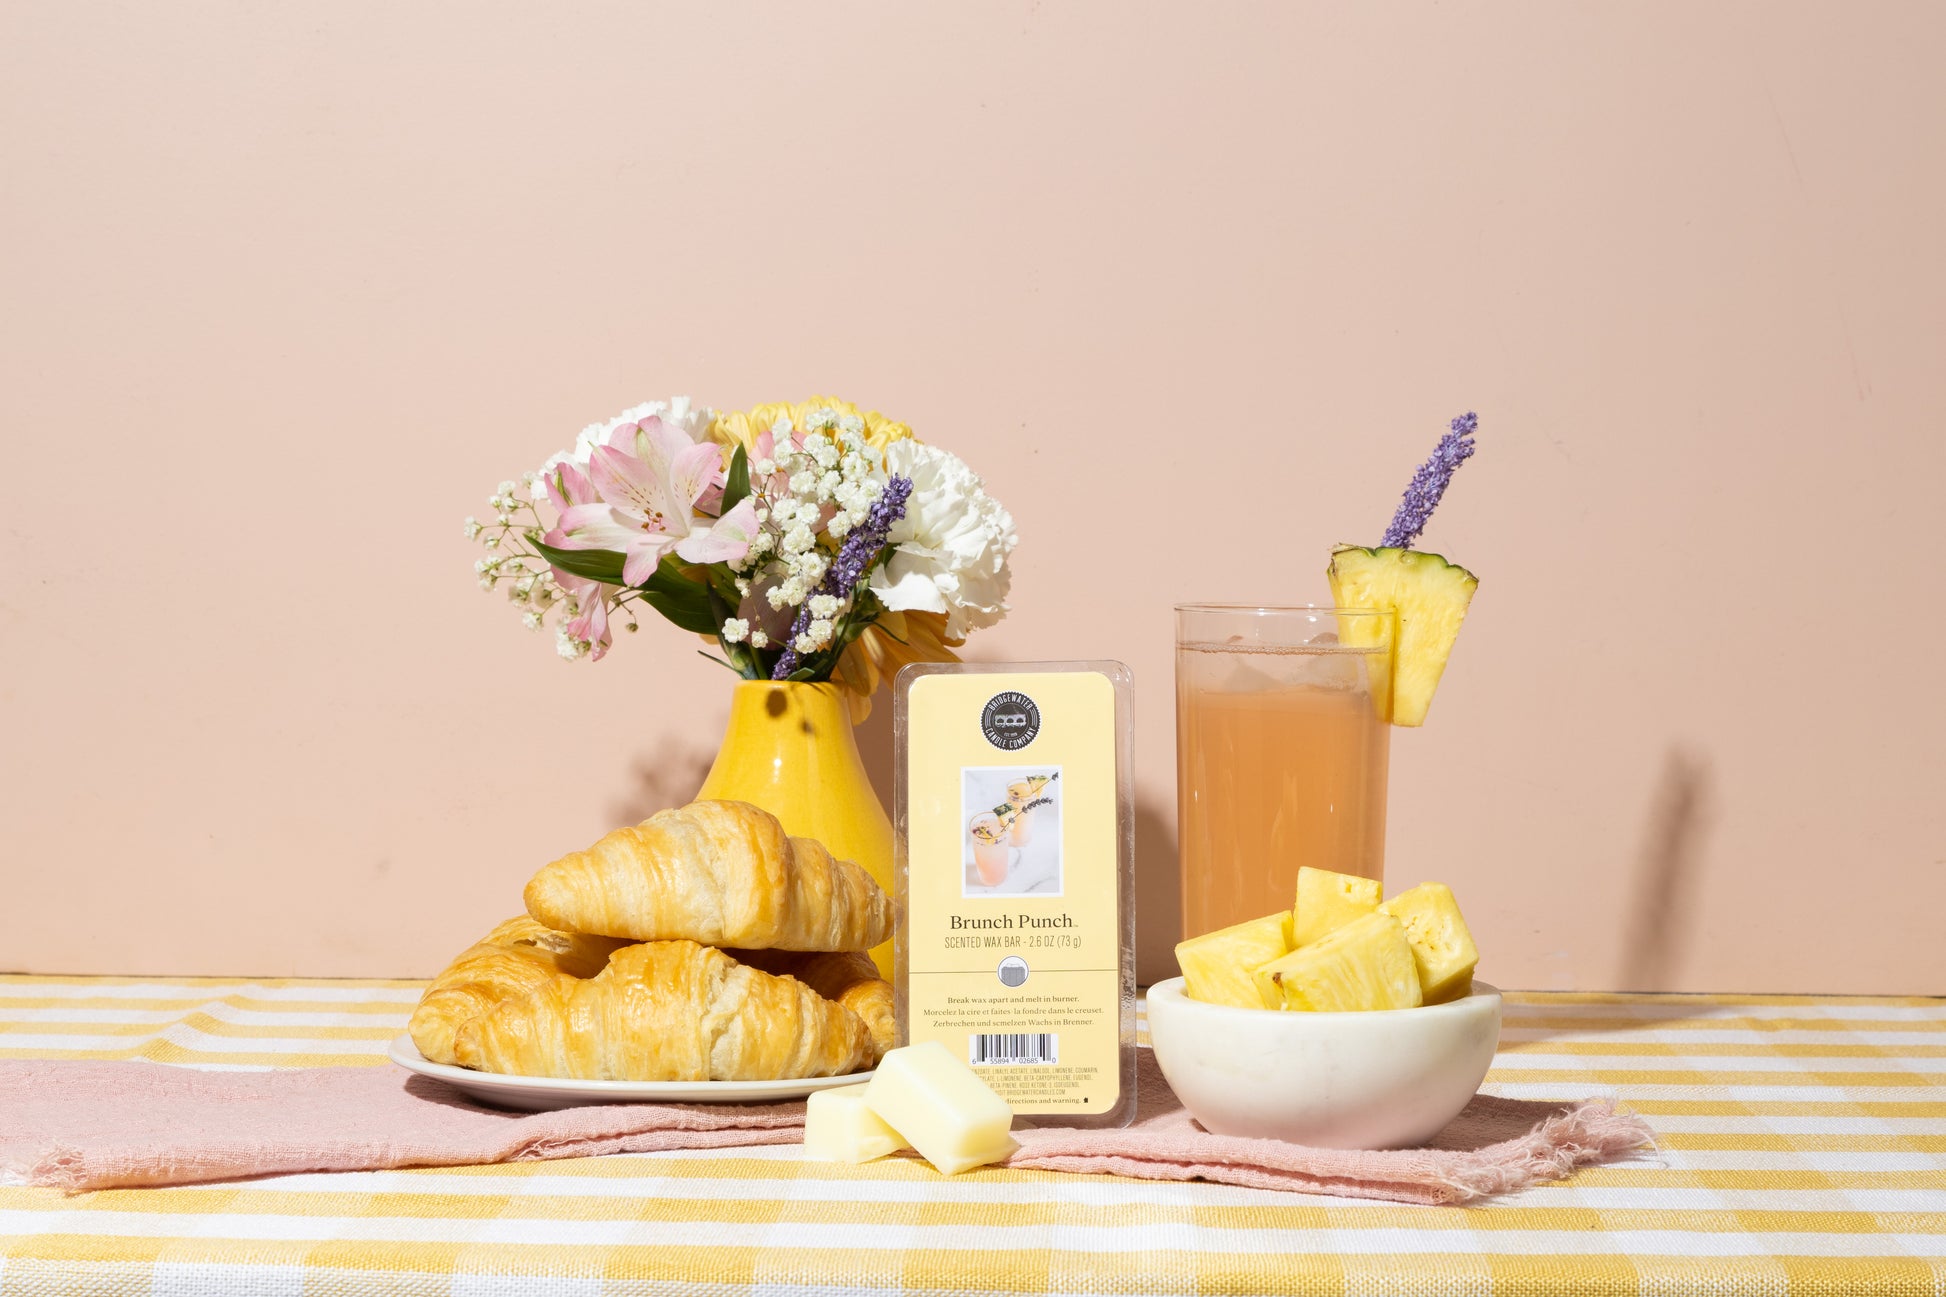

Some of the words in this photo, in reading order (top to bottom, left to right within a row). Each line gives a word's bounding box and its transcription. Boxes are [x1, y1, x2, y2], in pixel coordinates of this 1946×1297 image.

[988, 694, 1033, 711] BRIDGEWATER
[986, 728, 1006, 748] CANDLE
[1009, 726, 1036, 749] COMPANY
[950, 914, 1013, 930] Brunch
[944, 936, 981, 949] SCENTED
[983, 936, 1002, 948] WAX
[1004, 936, 1021, 948] BAR
[1029, 935, 1042, 948] 2.6
[1044, 935, 1055, 948] OZ
[1057, 935, 1072, 948] (73
[1073, 936, 1082, 949] g)
